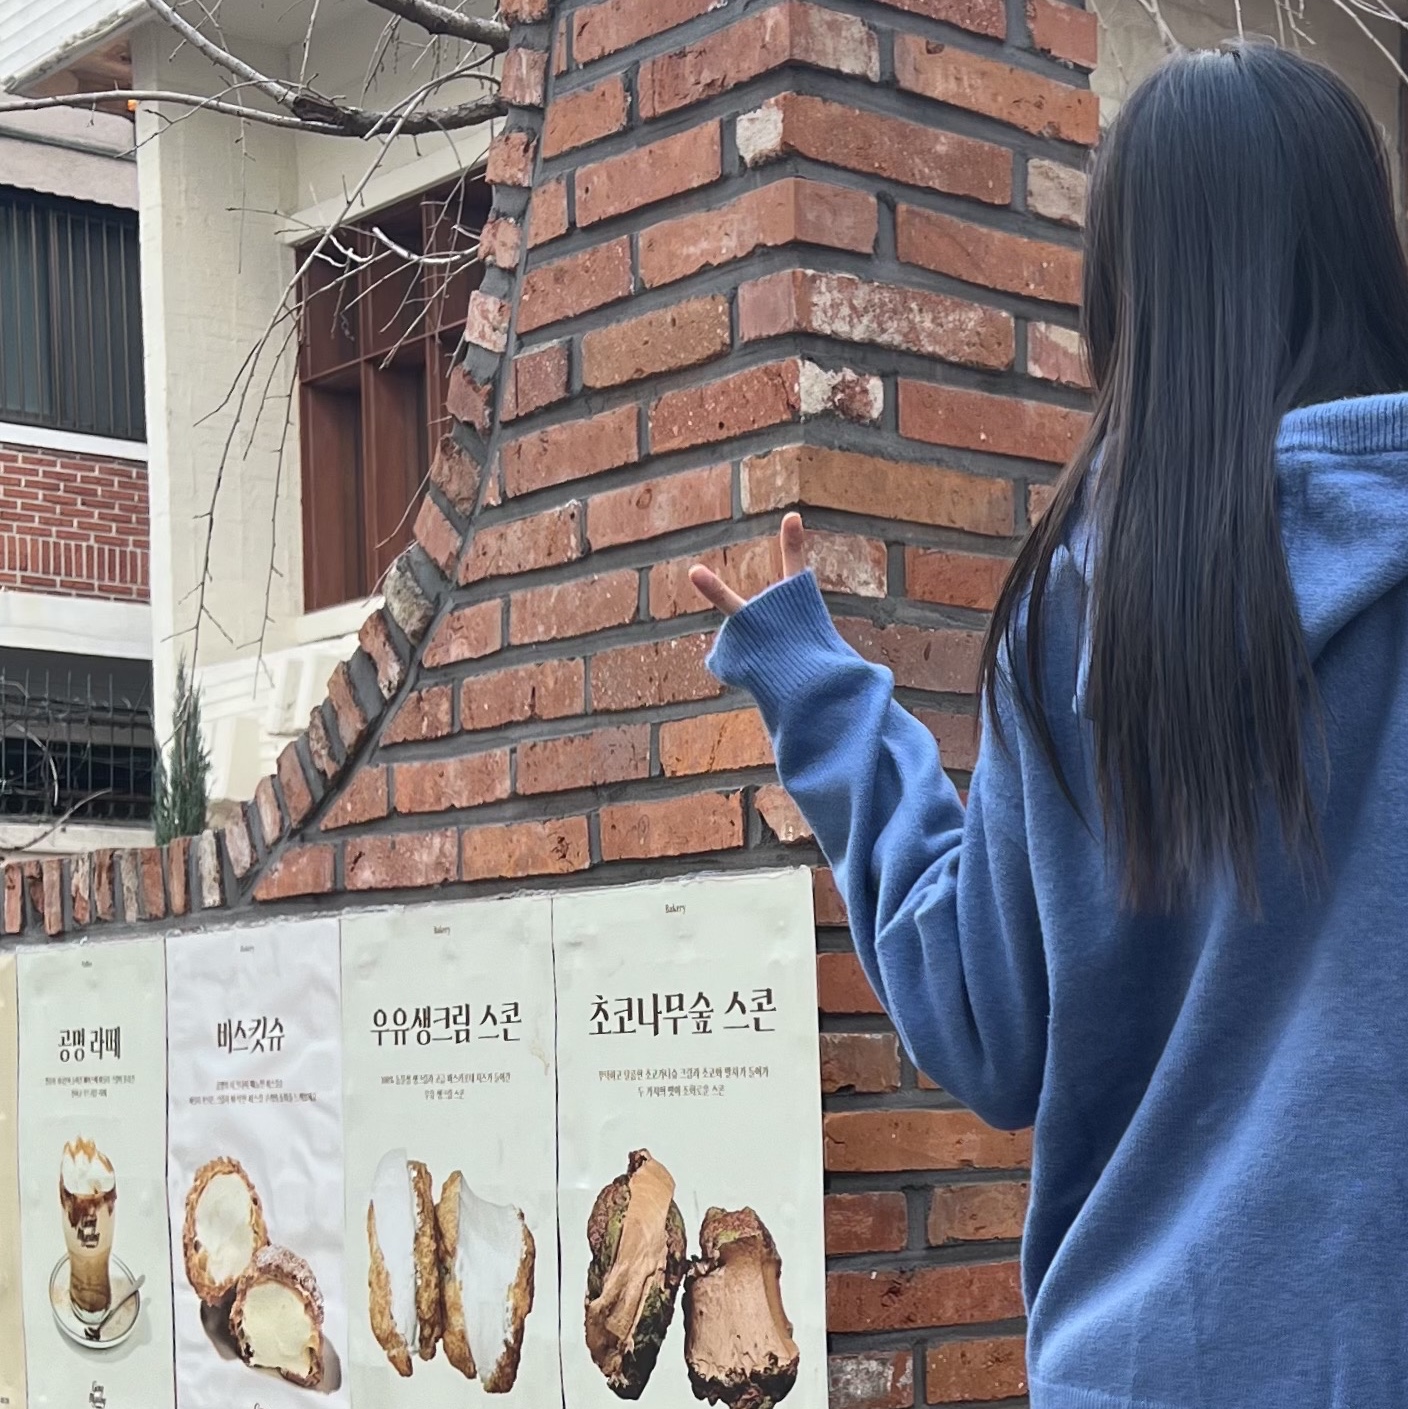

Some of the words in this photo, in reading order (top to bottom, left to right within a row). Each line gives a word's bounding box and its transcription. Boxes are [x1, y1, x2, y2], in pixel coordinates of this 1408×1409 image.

[370, 1003, 470, 1046] 우유생크림
[478, 1001, 522, 1042] 스콘
[589, 990, 713, 1037] 초코나무숲
[723, 987, 777, 1033] 스콘
[58, 1027, 86, 1062] 공명
[90, 1026, 121, 1060] 라떼
[217, 1016, 285, 1054] 비스킷슈
